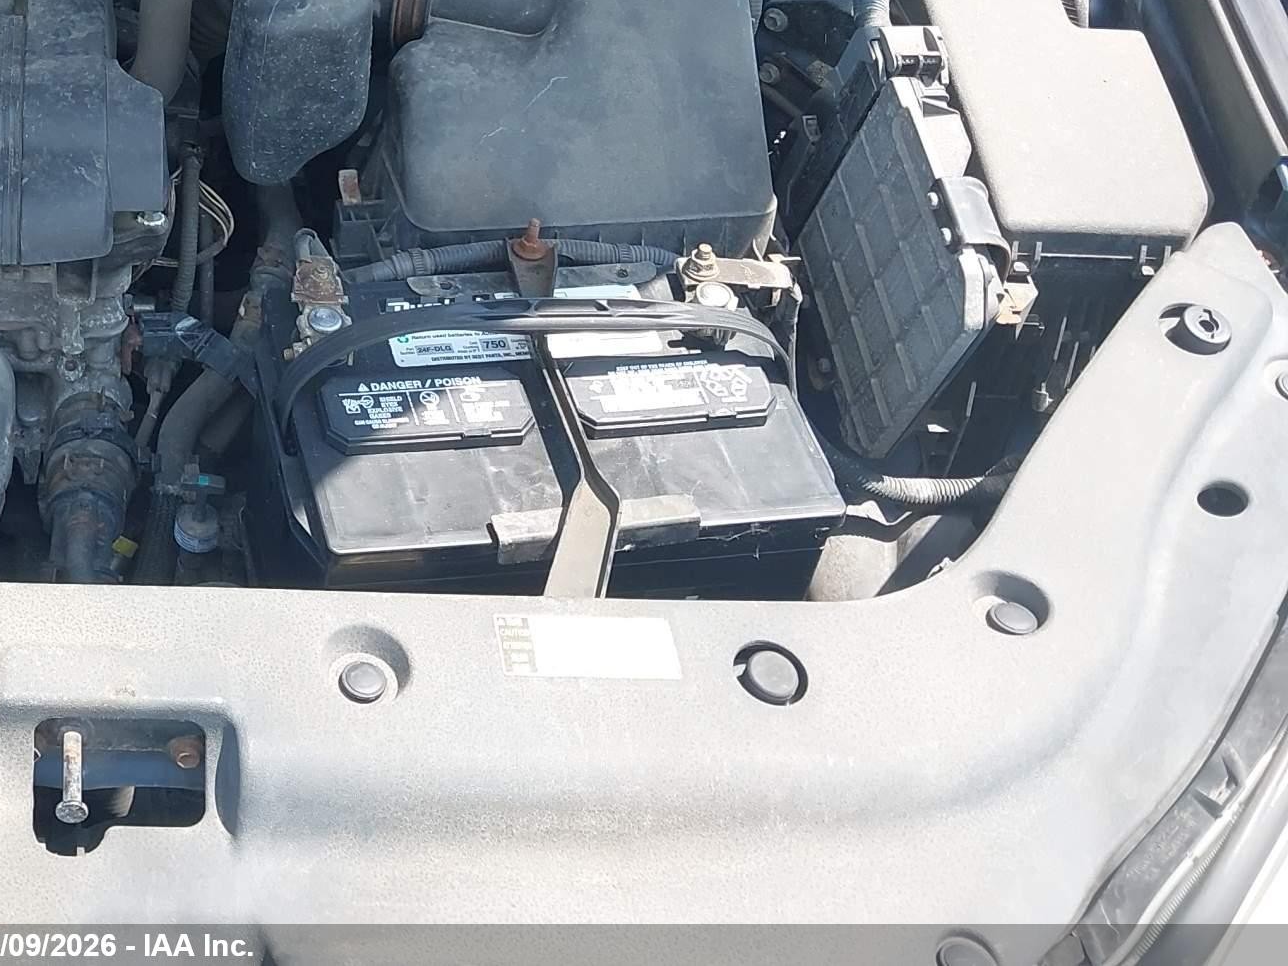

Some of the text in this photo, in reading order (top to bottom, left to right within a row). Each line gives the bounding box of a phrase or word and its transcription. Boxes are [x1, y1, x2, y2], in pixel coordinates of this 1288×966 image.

[483, 339, 506, 349] 750
[370, 380, 422, 391] DANGER
[434, 376, 481, 387] POISON
